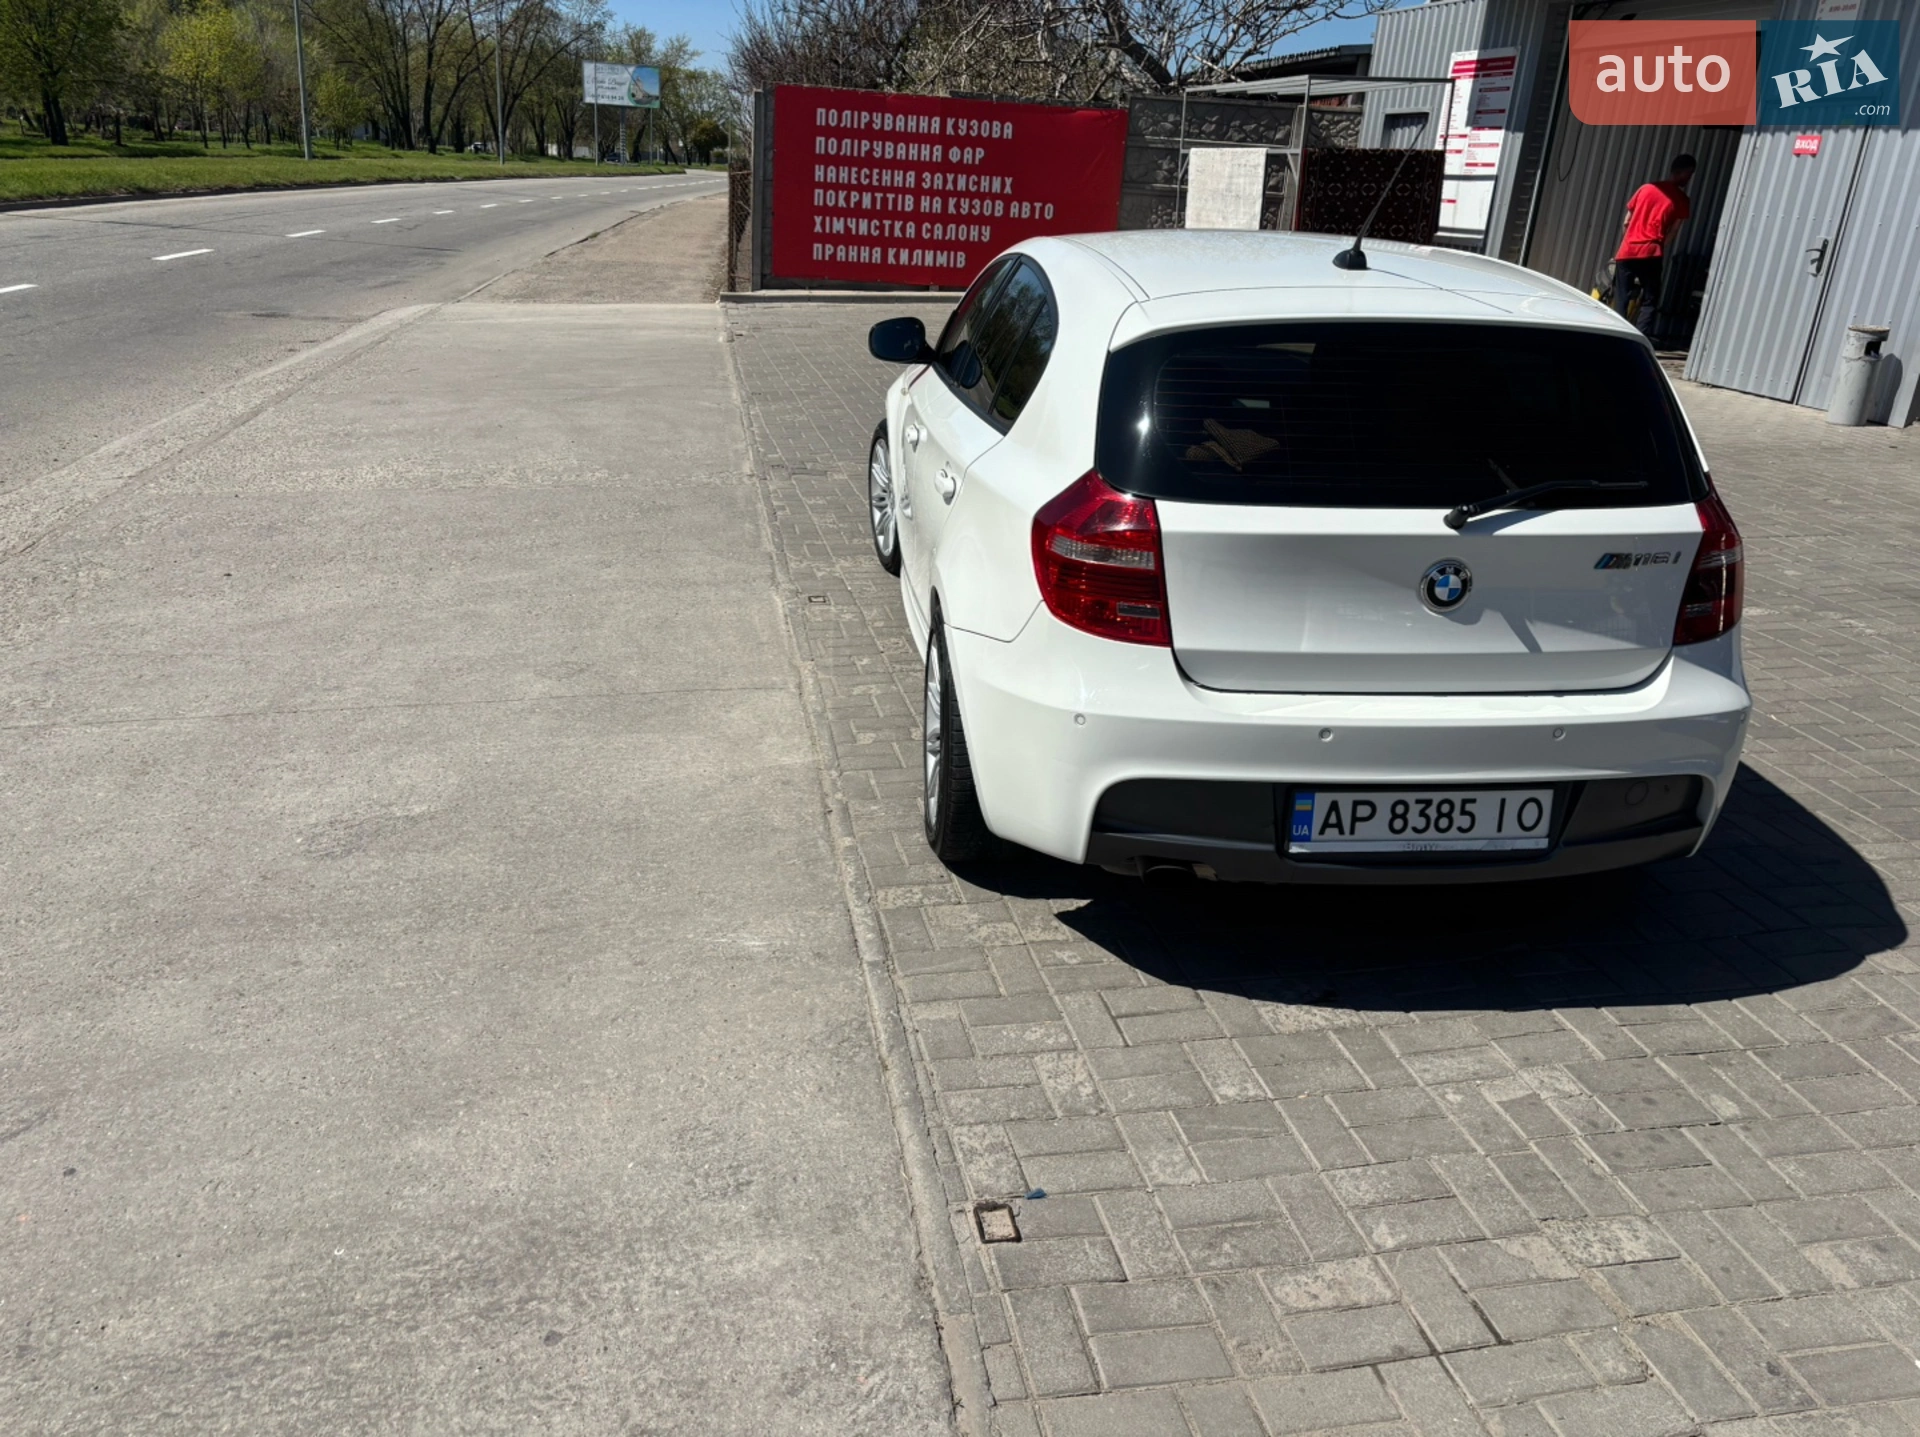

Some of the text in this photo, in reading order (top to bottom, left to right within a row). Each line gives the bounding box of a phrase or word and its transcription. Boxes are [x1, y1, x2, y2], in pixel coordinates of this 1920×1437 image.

[816, 107, 1013, 140] ПОЛІРУВАННЯ КУЗОВА
[815, 136, 985, 165] ПОЛІРУВАННЯ ФАР
[1795, 138, 1819, 151] ВХОД
[814, 164, 1013, 194] НАНЕСЕННЯ ЗАХИСНИХ
[813, 188, 1054, 220] ПОКРИТТІВ НА КУЗОВ АВТО
[813, 215, 991, 243] ХІМЧИСТКА САЛОНУ
[812, 243, 967, 269] ПРАННЯ КИЛИМІВ
[1292, 825, 1310, 837] UA
[1318, 797, 1544, 836] AP 8385 IO
